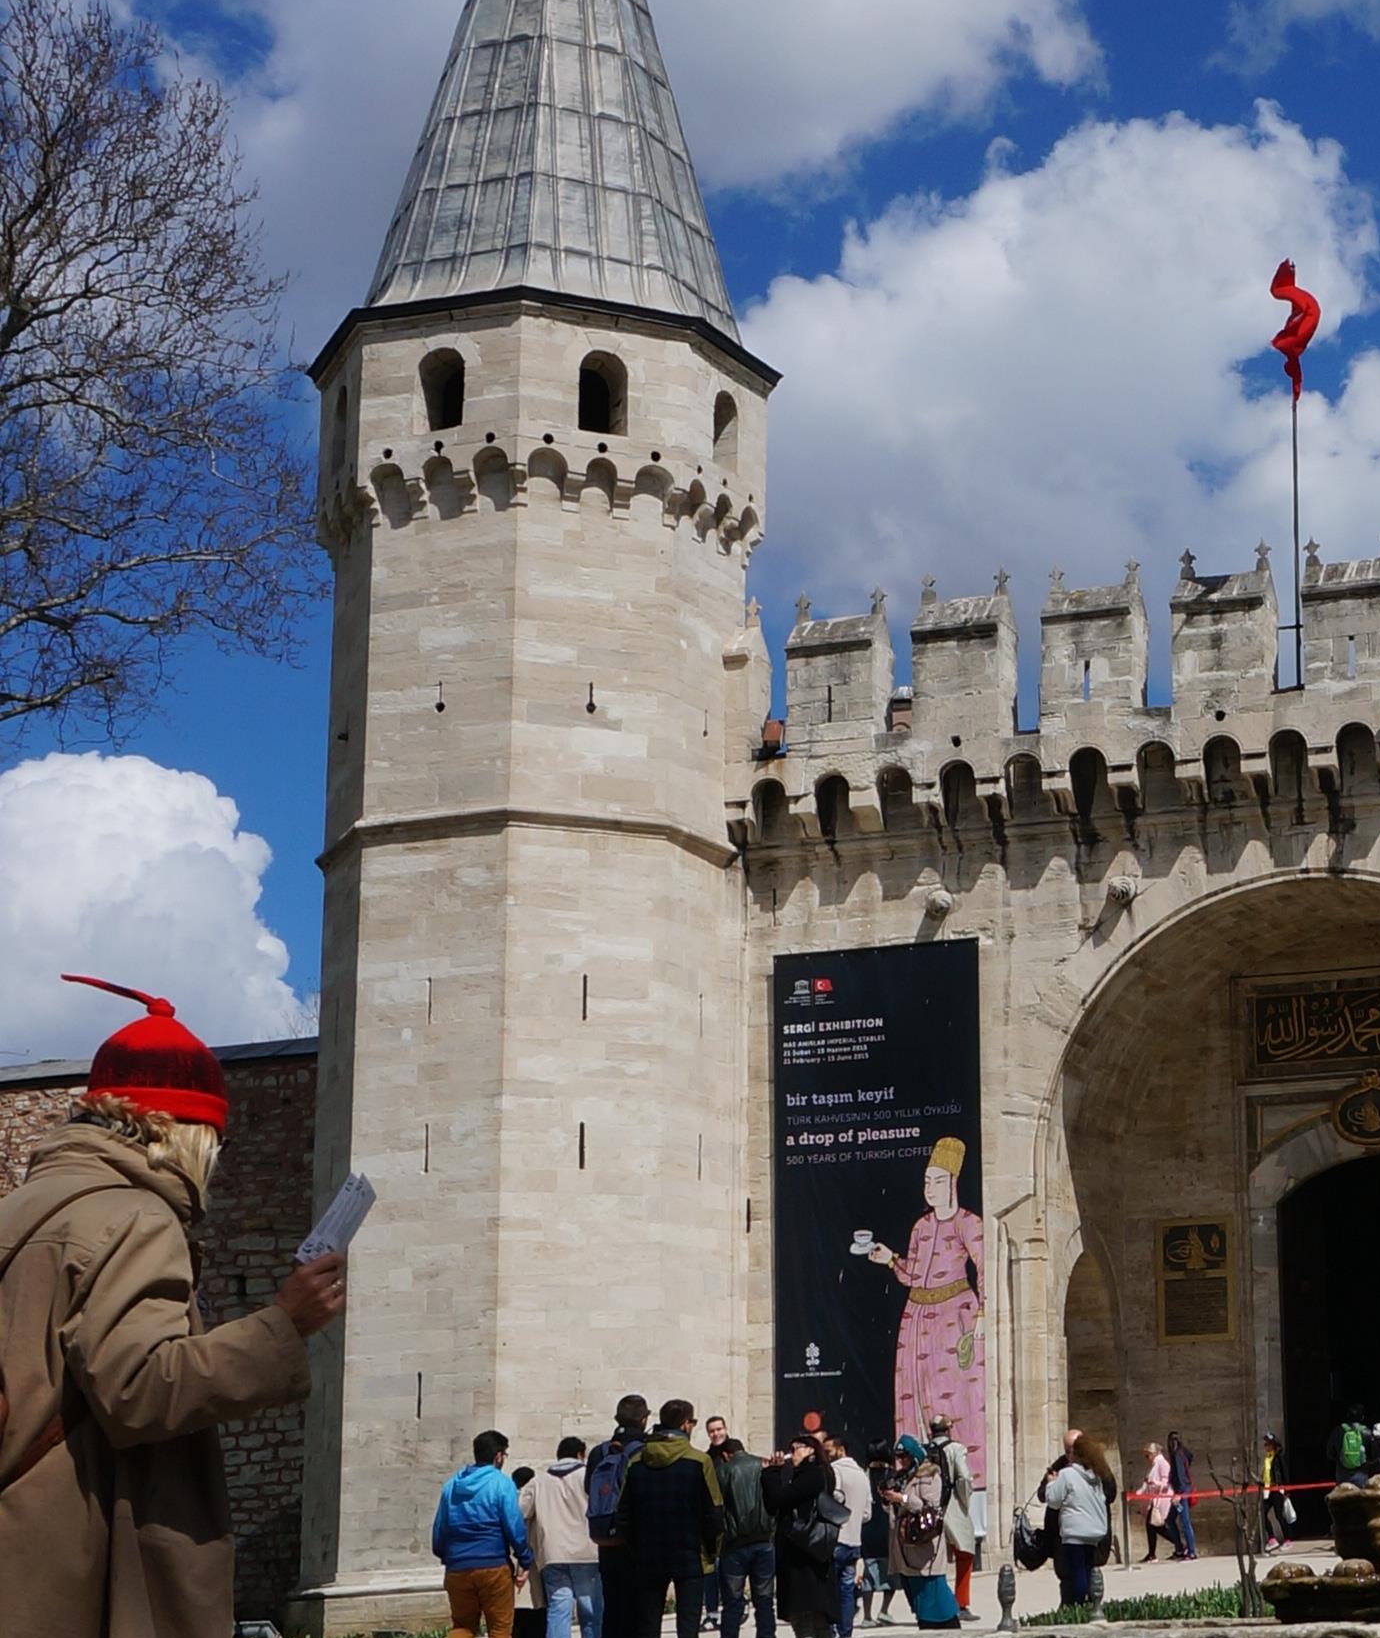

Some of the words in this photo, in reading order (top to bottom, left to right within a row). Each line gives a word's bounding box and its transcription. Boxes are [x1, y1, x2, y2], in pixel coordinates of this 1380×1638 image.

[783, 1021, 815, 1035] SERGİ
[819, 1018, 883, 1031] EXHIBITION
[786, 1093, 808, 1106] bir
[811, 1092, 853, 1107] taşım
[857, 1086, 895, 1103] keyif
[873, 1110, 892, 1121] 500
[786, 1135, 795, 1146] a
[799, 1131, 834, 1146] drop
[838, 1129, 853, 1143] of
[857, 1126, 921, 1144] pleasure
[786, 1155, 804, 1165] 500
[806, 1152, 837, 1164] YEARS
[839, 1152, 853, 1162] OF
[855, 1149, 895, 1161] TURKISH
